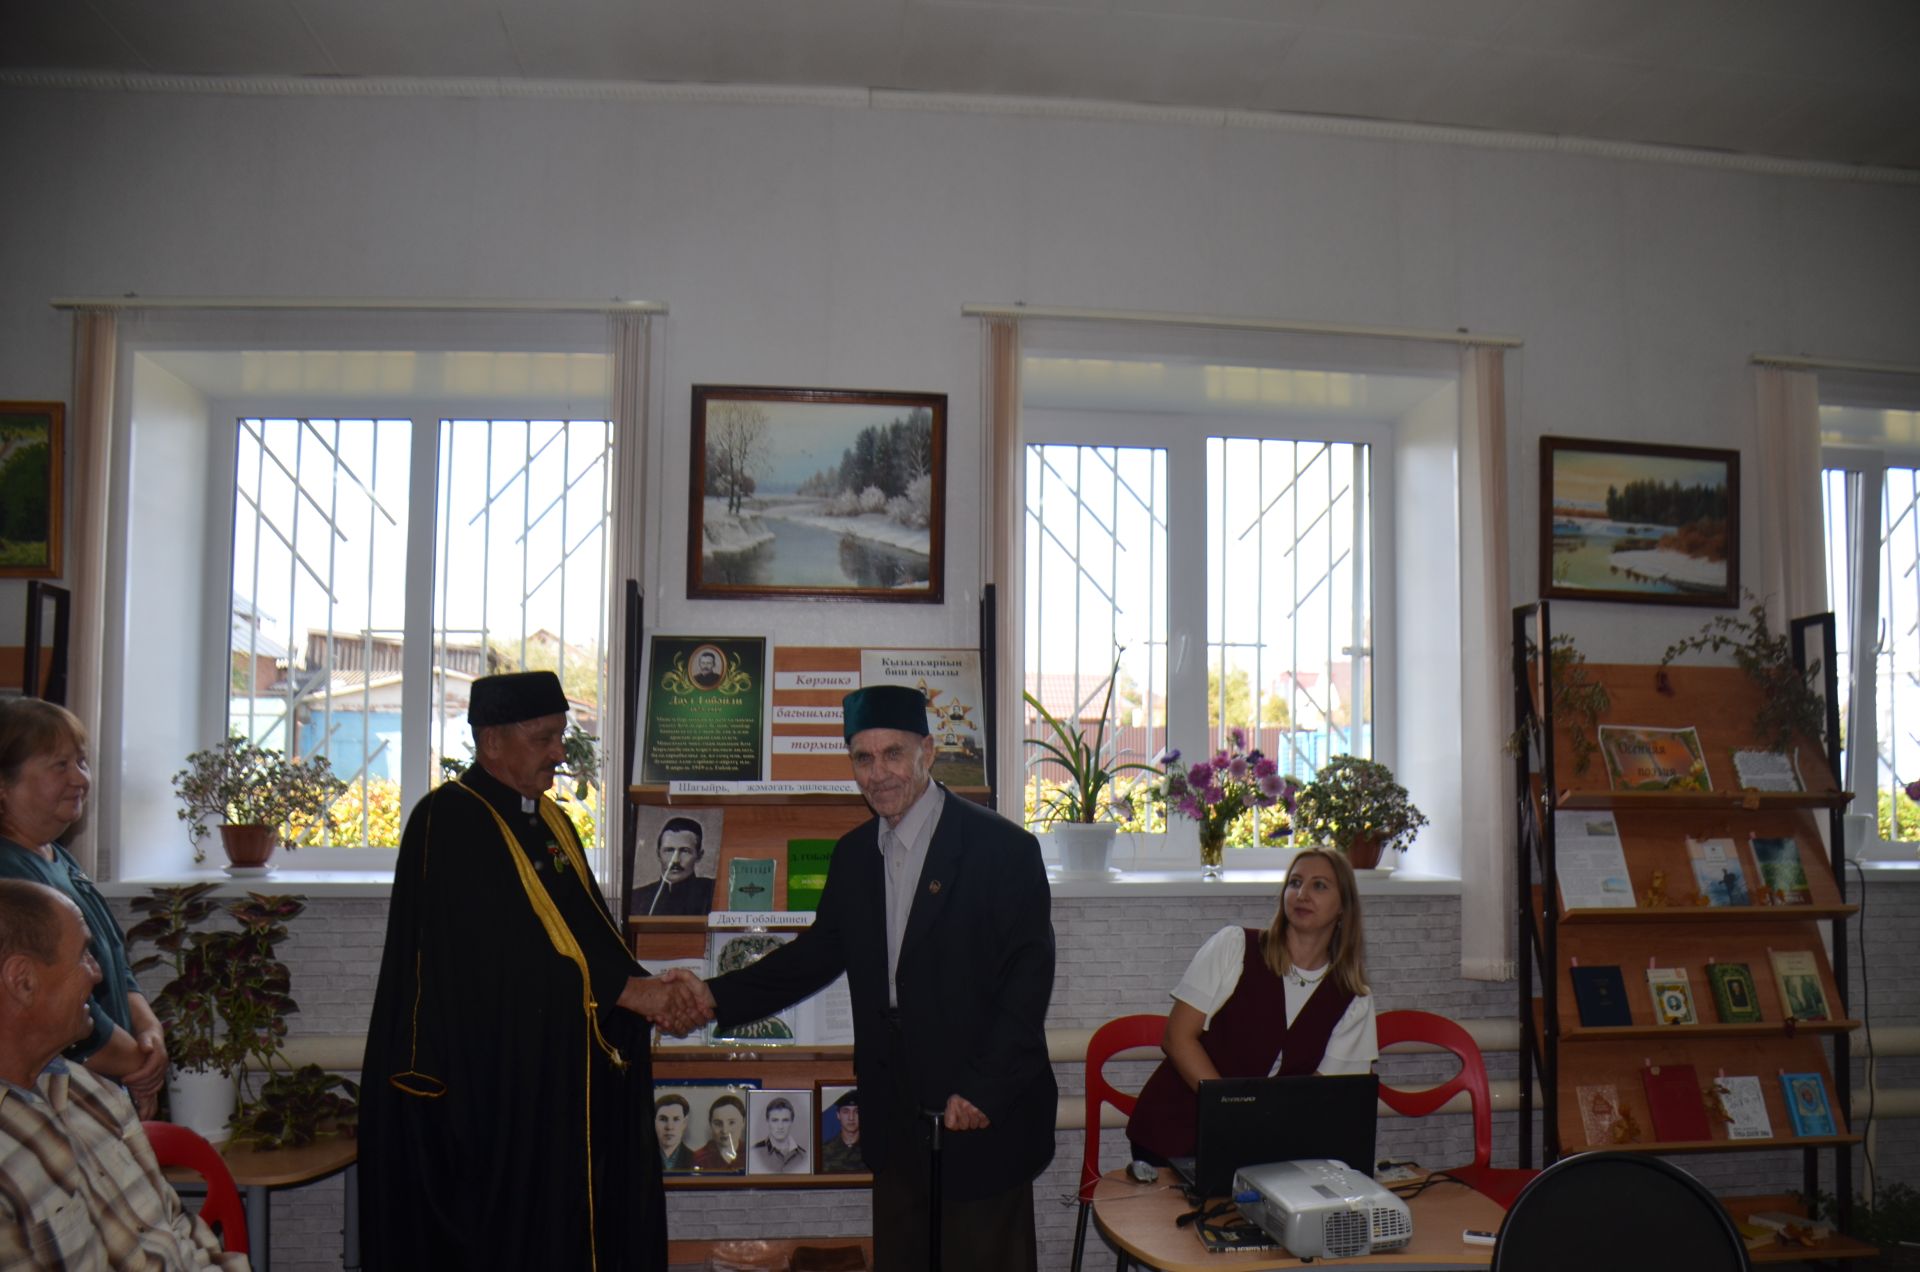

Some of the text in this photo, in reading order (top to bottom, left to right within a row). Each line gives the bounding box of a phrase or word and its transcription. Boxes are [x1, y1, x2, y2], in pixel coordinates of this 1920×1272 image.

[885, 668, 959, 677] биш йолдызы
[795, 674, 851, 687] Көрәшкә
[1637, 767, 1676, 776] поэзия
[678, 783, 854, 794] Шагыйрь, жәмәгать эшлеклесе,
[717, 914, 743, 926] Даут
